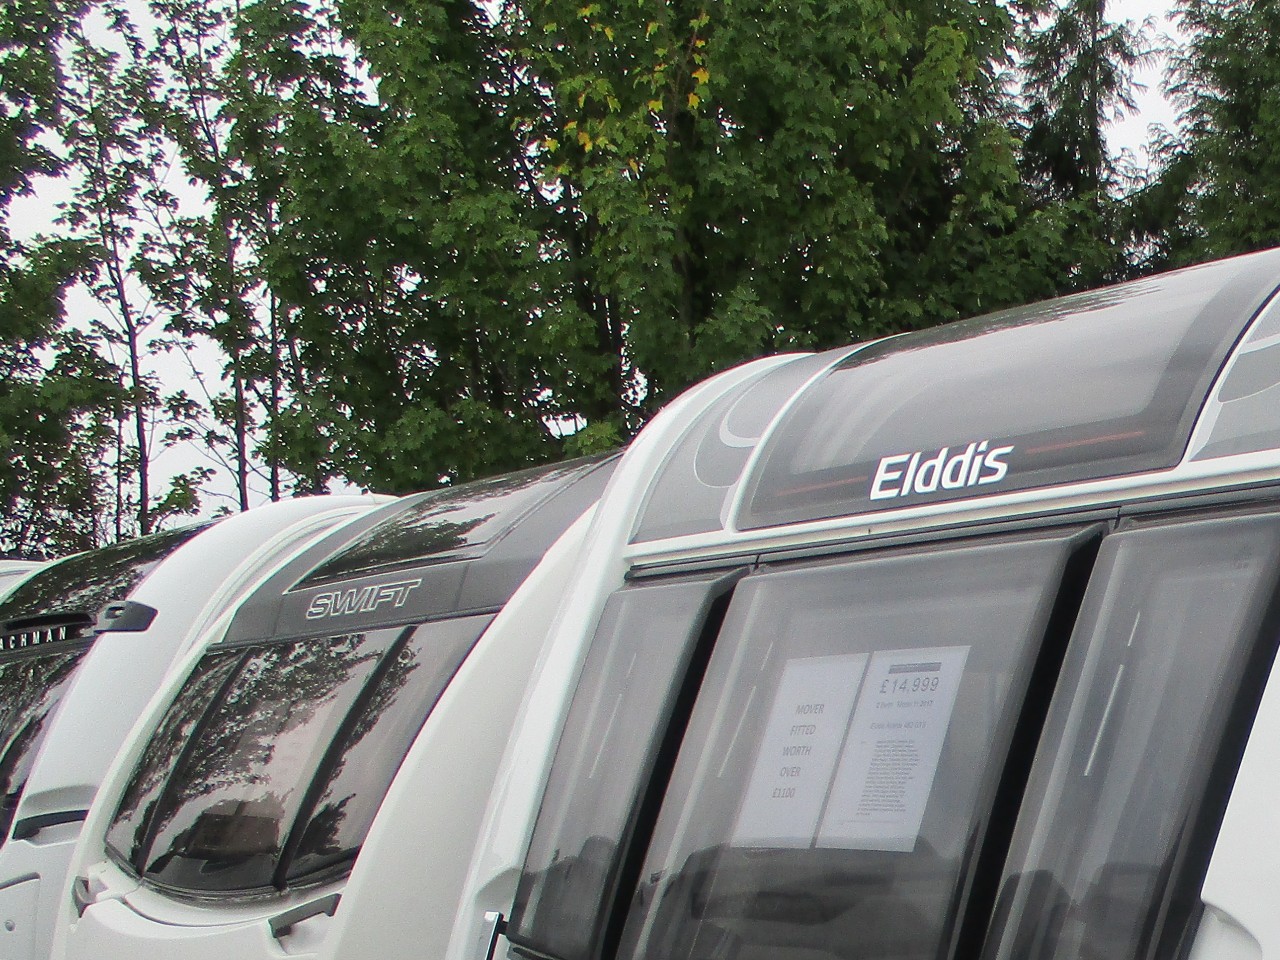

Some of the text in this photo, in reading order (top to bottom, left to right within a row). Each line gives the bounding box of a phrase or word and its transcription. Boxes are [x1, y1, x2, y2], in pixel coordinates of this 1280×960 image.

[870, 440, 1014, 500] Elddis
[306, 579, 422, 619] SWIFT
[796, 704, 824, 714] MOVER
[790, 725, 816, 735] FITTED
[783, 746, 811, 756] WORTH
[780, 767, 801, 777] OVER
